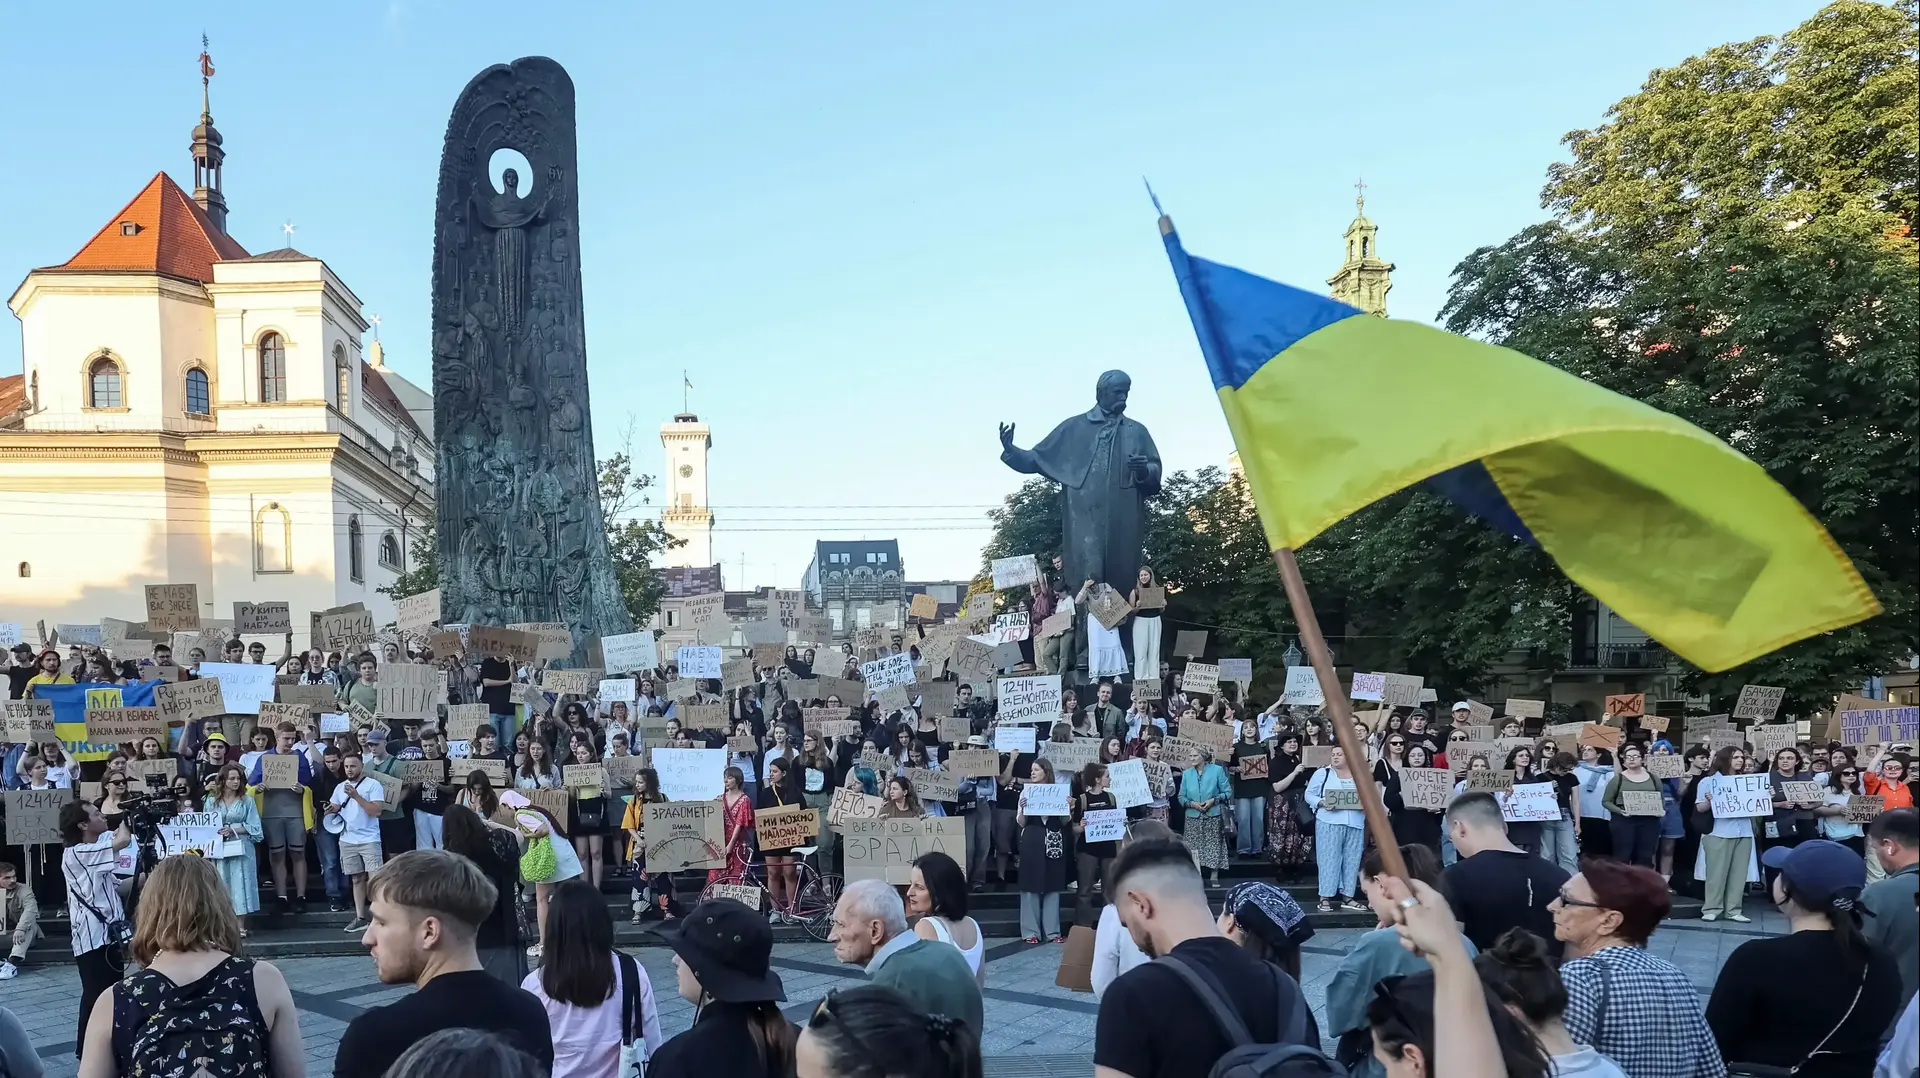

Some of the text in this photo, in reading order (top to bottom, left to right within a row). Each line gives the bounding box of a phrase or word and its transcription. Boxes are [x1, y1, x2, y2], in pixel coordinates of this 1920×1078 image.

[164, 586, 193, 600] НАБУ
[150, 601, 193, 611] ВАС ЗНЕСЕ
[691, 606, 713, 616] НАБУ
[779, 601, 799, 610] ТУТ
[694, 615, 712, 624] САП
[780, 610, 794, 618] НЕ
[996, 612, 1028, 627] ЗА НАБУ
[178, 617, 197, 628] МИ
[244, 620, 290, 629] НАБУ САП
[324, 615, 373, 638] 12414
[780, 618, 800, 629] ОСІЯ
[330, 637, 345, 649] НЕ
[878, 660, 886, 671] НЕ
[550, 678, 584, 693] ЗРАДИ
[1003, 680, 1034, 693] 12414
[1353, 681, 1385, 693] ЗРАДА!
[1003, 689, 1059, 708] ДЕМОНТАЖ
[1309, 688, 1324, 700] ЗРА
[1744, 686, 1782, 699] БАЧИМО
[161, 697, 192, 716] НАБУ
[1761, 698, 1777, 707] ХТО
[36, 704, 51, 716] ВАС
[90, 709, 160, 722] РУСНЯ ВБИВАЄ
[262, 703, 289, 716] НАБУ
[1003, 700, 1060, 721] ДЕМОКРАТІЇ!
[1646, 716, 1666, 725] VETO
[1841, 709, 1883, 727] БУДЬ-ЯКА
[1842, 726, 1893, 745] ТЕПЕР ПІД
[63, 740, 118, 754] UKRA
[1165, 746, 1190, 755] НЕЗАЛ
[863, 752, 888, 763] 12414
[1651, 757, 1681, 767] 12414
[605, 760, 629, 769] 12414
[910, 770, 941, 783] 12414
[1404, 769, 1448, 784] ХОЧЕТЕ
[1417, 783, 1447, 793] РУЧНЕ
[1482, 779, 1511, 790] ЗРАДИ
[1734, 775, 1769, 793] ГЕТЬ
[1785, 782, 1819, 793] ВЕТО
[933, 785, 958, 799] ЗРАДИ
[1026, 785, 1061, 799] 12414
[1411, 790, 1448, 806] НАБУ
[16, 793, 63, 811] 12414
[1746, 796, 1771, 813] САП
[1851, 804, 1877, 813] НОМЕР
[652, 806, 715, 821] ЗРАДОМЕТР
[1503, 803, 1523, 818] НЕ
[13, 814, 47, 829] ТЕХ
[171, 811, 219, 828] МОКРАТІЯ?
[763, 813, 814, 828] МИ МОЖЕМО
[11, 828, 60, 843] ВОРО
[173, 828, 193, 843] НІ,
[760, 827, 798, 841] МАЙДАН
[1089, 830, 1118, 838] ЯНИКА
[848, 836, 946, 864] ЗРАДА
